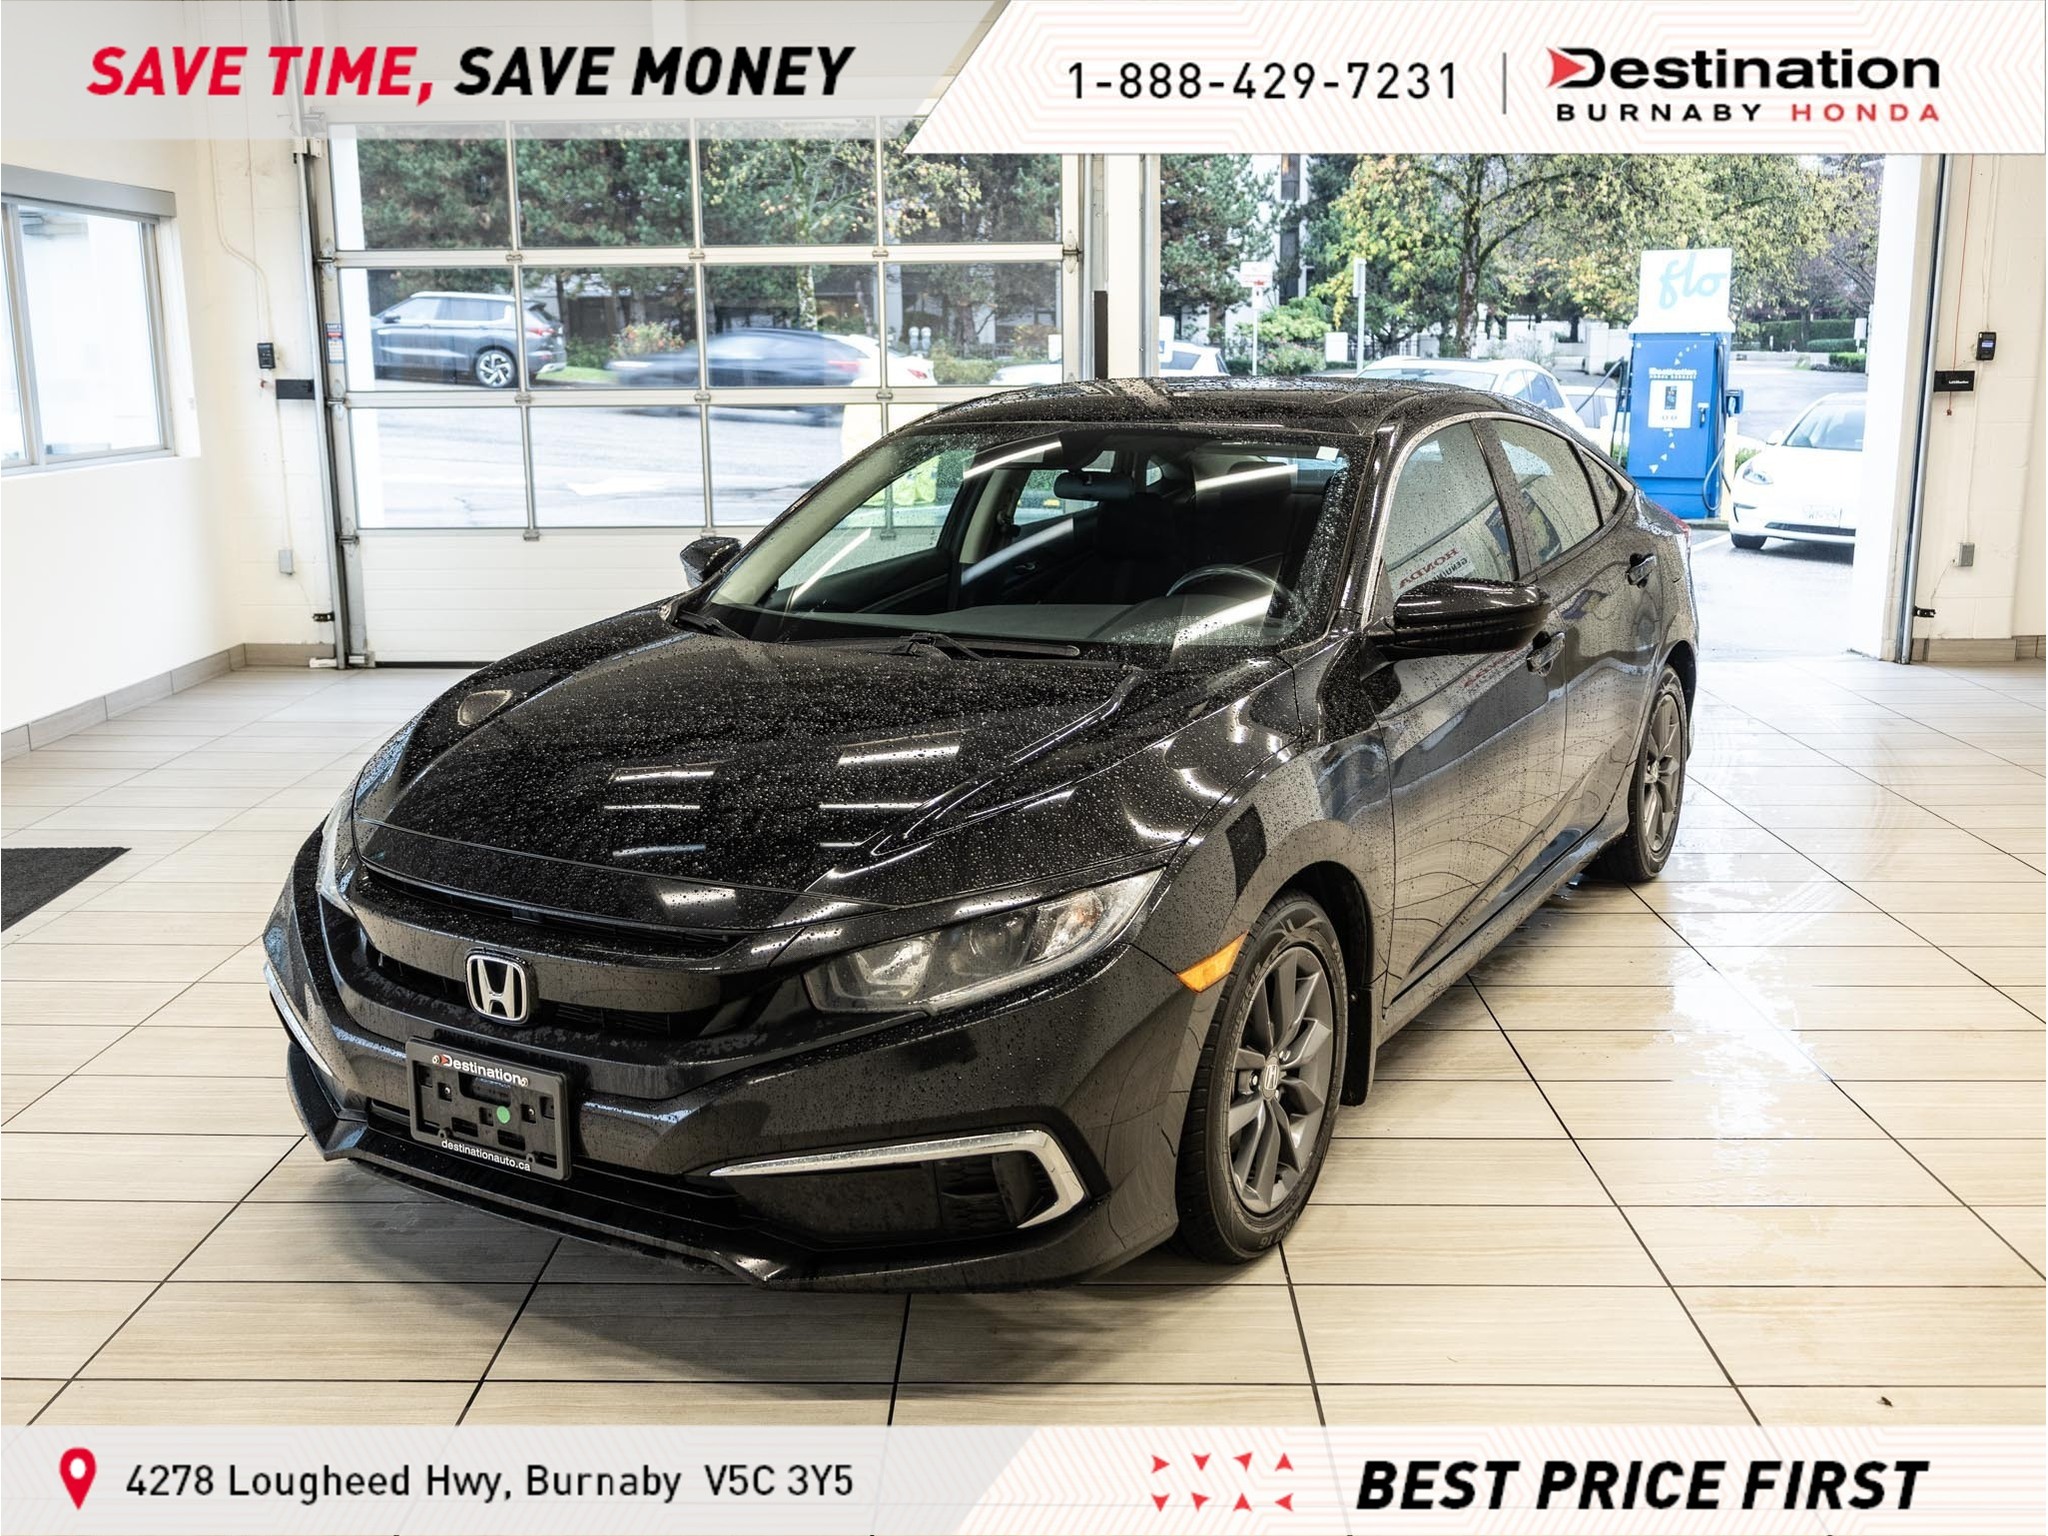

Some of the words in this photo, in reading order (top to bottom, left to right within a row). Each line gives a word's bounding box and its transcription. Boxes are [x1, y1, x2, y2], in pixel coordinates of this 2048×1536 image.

[1659, 252, 1728, 310] flo
[440, 1054, 522, 1085] Destination
[441, 1139, 531, 1172] destinationauto.ca
